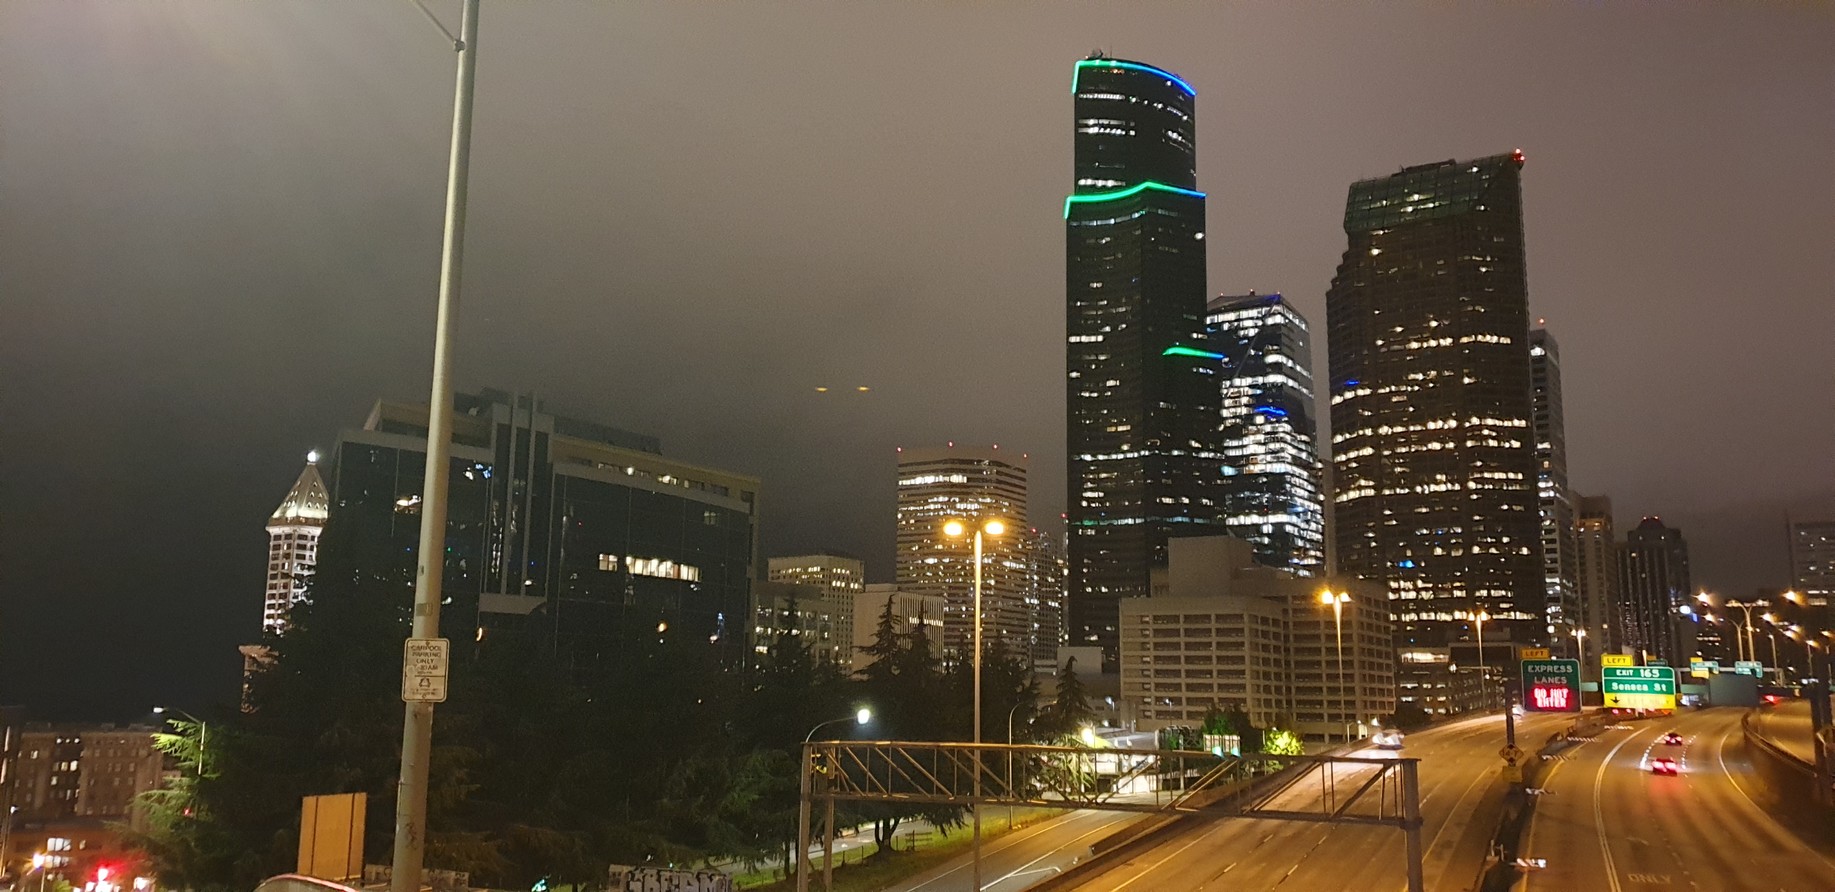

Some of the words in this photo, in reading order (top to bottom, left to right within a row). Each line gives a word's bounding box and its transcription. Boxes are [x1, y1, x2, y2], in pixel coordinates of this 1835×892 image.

[1528, 665, 1573, 673] EXPRESS
[1640, 668, 1660, 678] 165
[1534, 676, 1567, 684] LANES
[1611, 682, 1649, 691] Seneca
[1653, 682, 1666, 692] St
[1534, 688, 1547, 698] DO
[1550, 688, 1569, 699] NOT
[1537, 697, 1566, 708] ENTER
[1627, 873, 1671, 884] ONLY
